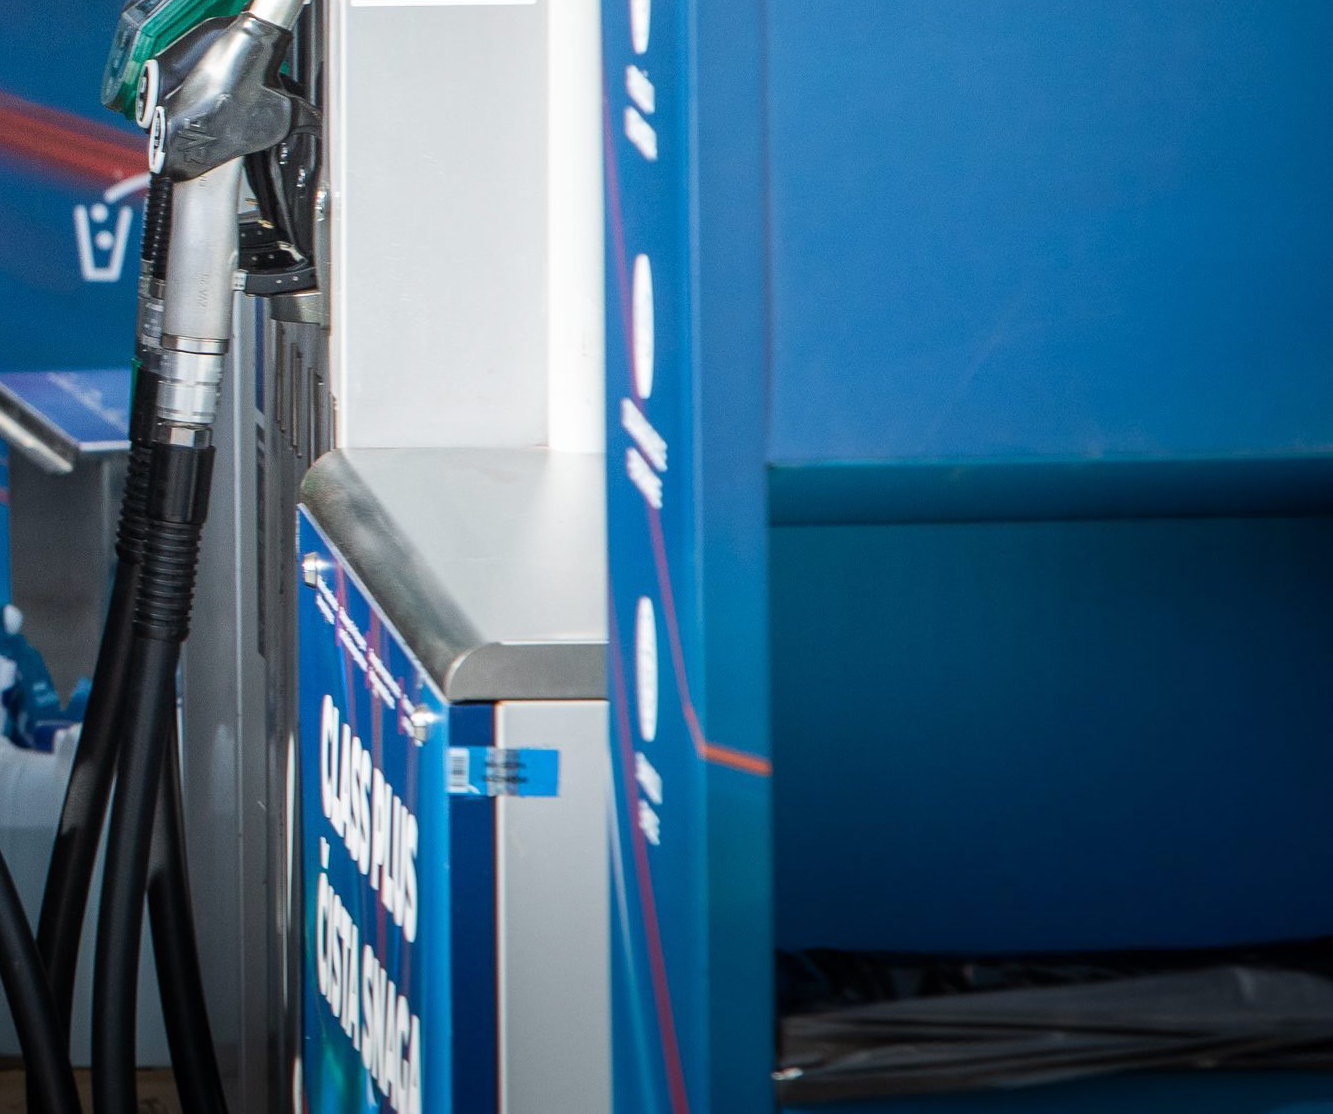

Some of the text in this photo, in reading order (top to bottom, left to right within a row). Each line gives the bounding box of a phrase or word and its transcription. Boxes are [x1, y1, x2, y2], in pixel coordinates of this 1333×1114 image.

[320, 694, 371, 876] CLASS
[370, 767, 419, 944] PLUS
[317, 836, 424, 1114] ČISTA SNAGA
